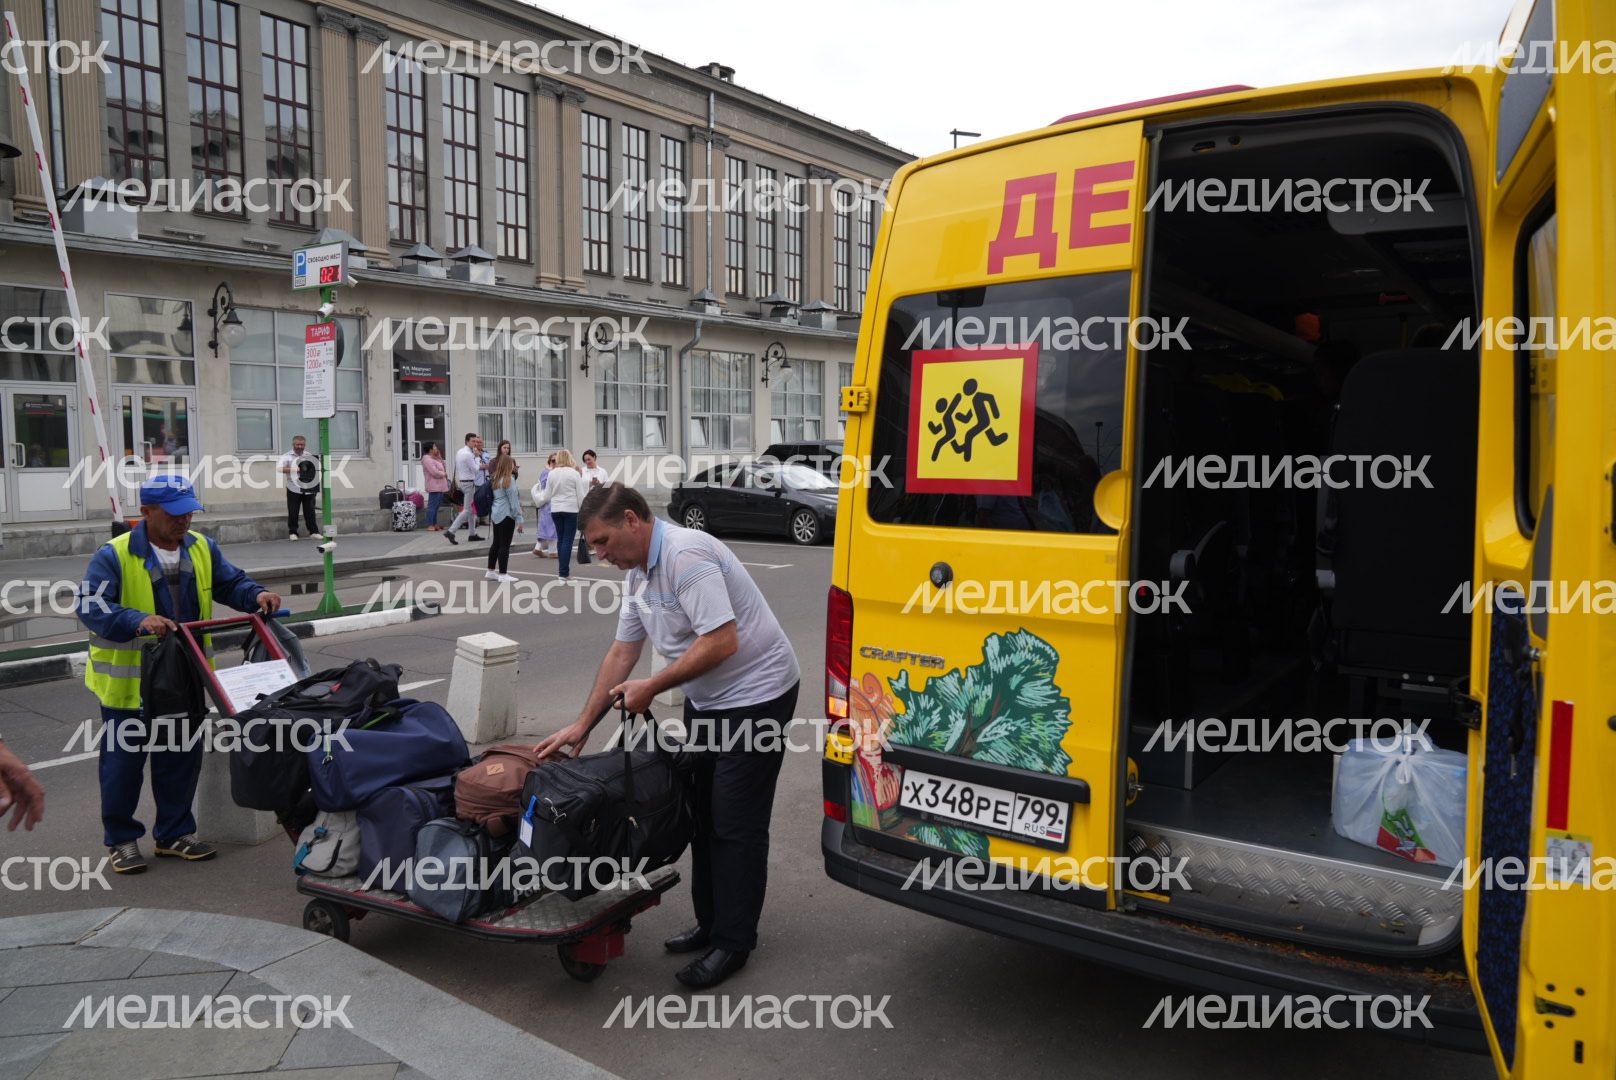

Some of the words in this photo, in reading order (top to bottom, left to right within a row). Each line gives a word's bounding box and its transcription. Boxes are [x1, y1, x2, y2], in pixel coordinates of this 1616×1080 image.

[987, 160, 1135, 275] ДЕ
[310, 326, 331, 337] ТАРИФ
[859, 646, 945, 669] CRAFTER
[1017, 796, 1059, 827] 799
[1024, 822, 1046, 835] RUS
